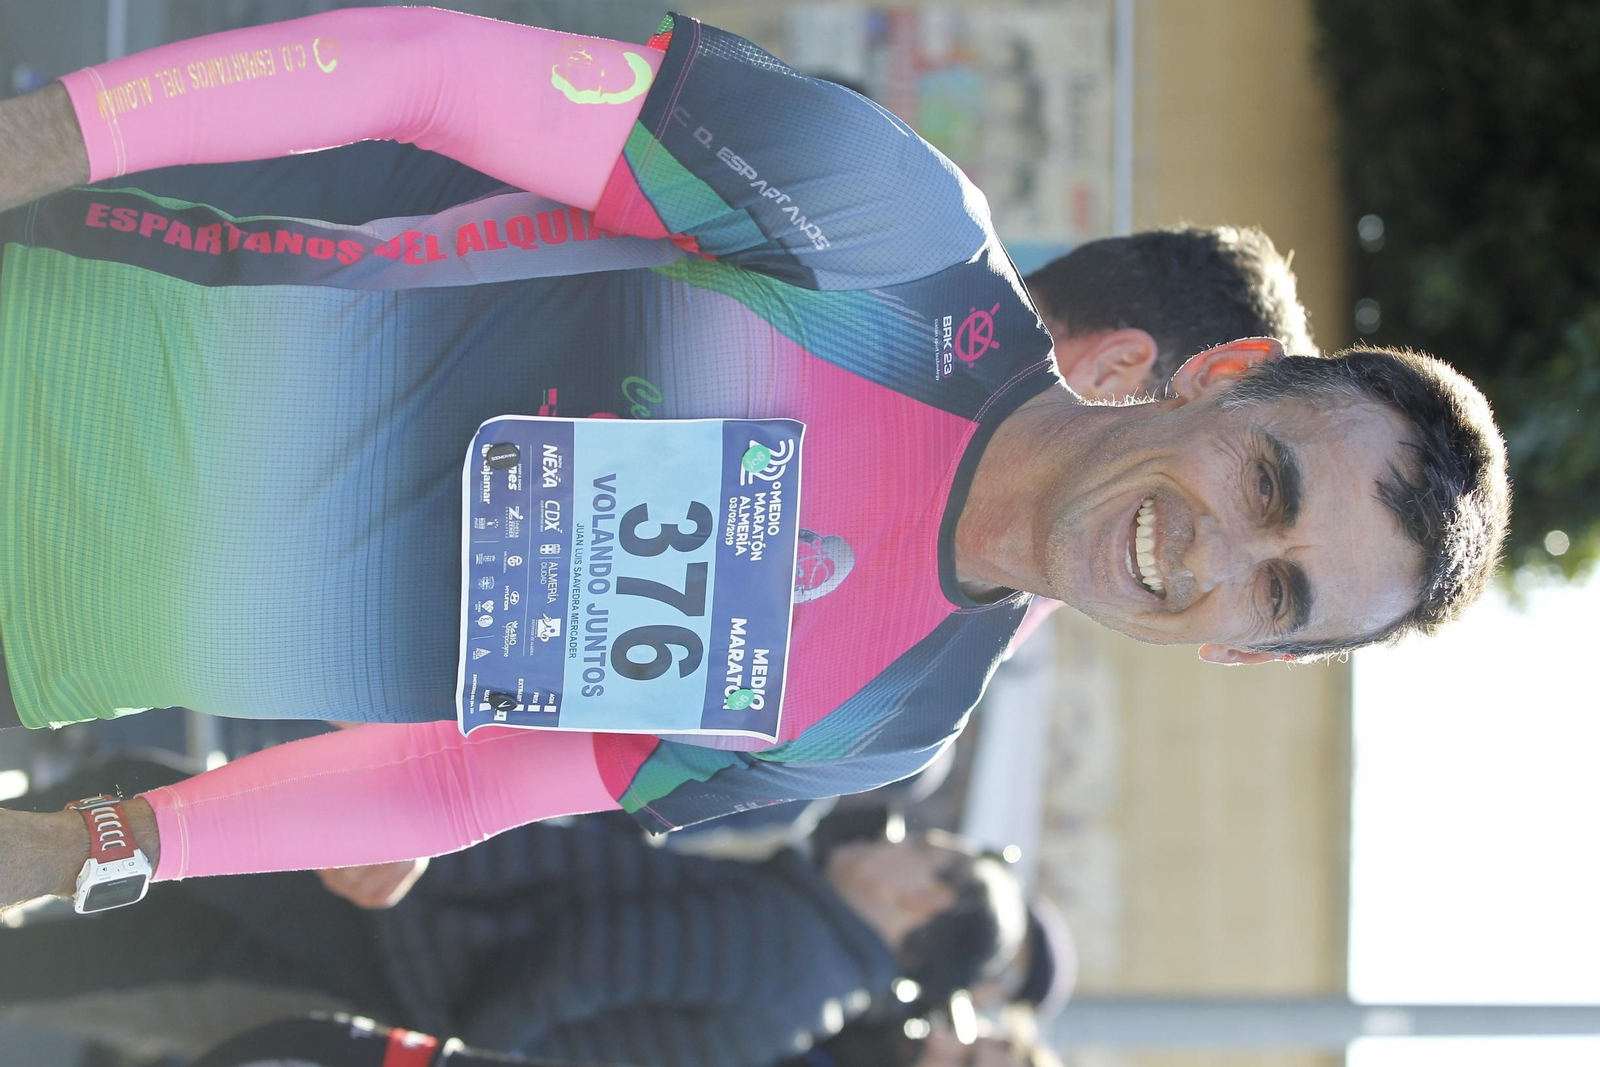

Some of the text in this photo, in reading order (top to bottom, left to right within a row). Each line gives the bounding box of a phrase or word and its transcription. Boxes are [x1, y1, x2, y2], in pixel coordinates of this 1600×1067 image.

[155, 67, 186, 98] DEL
[188, 49, 275, 90] ESPARTANOS
[716, 146, 830, 250] ESPARTANOS
[85, 203, 364, 264] ESPARTANOS
[943, 316, 952, 374] BRK 23
[543, 444, 560, 488] NEXA
[545, 500, 562, 533] CDX
[725, 497, 737, 546] 03/02/2019
[735, 496, 750, 556] ALMERÍA
[750, 492, 766, 561] MARATÓN
[768, 491, 782, 536] MEDIO
[547, 562, 559, 604] ALMERÍA
[569, 523, 584, 658] JUAN LUIS SAAVEDRA MERCADER
[581, 473, 616, 697] VOLANDO JUNTOS
[610, 501, 713, 681] 376
[749, 649, 769, 710] MEDIO
